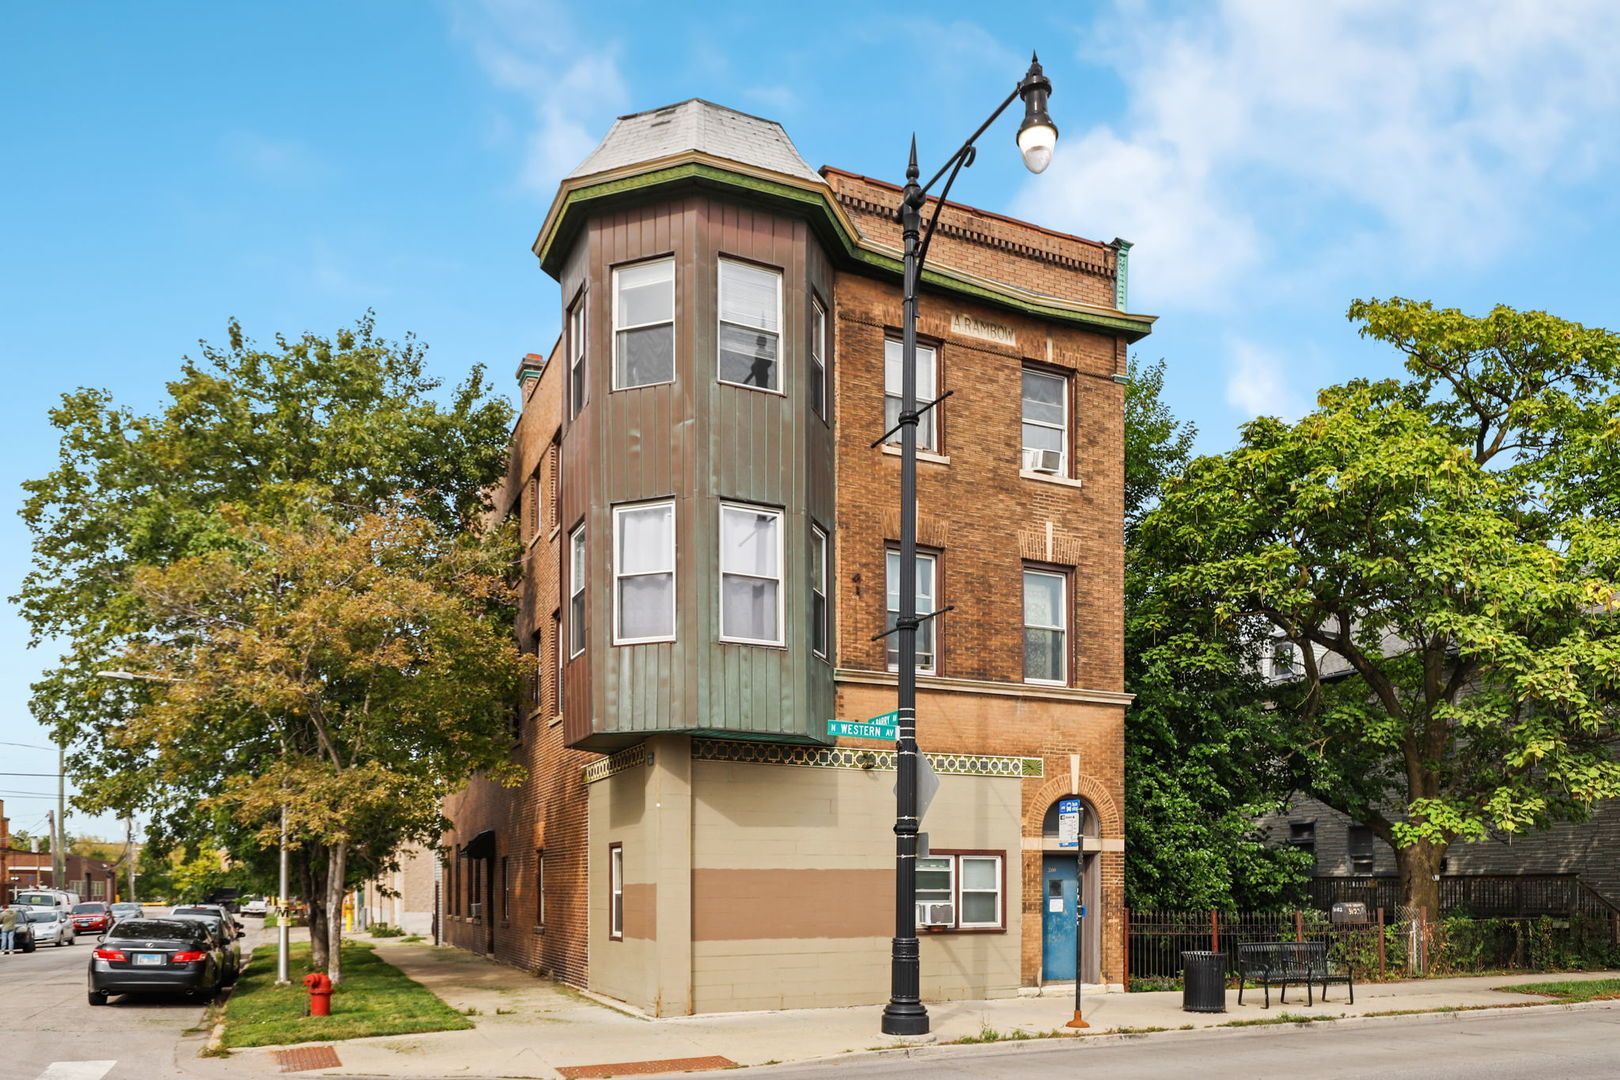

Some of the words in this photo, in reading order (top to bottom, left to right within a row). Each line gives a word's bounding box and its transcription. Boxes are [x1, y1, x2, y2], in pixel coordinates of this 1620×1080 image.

[831, 723, 836, 732] N
[841, 723, 881, 737] WESTERN
[885, 728, 894, 737] AV
